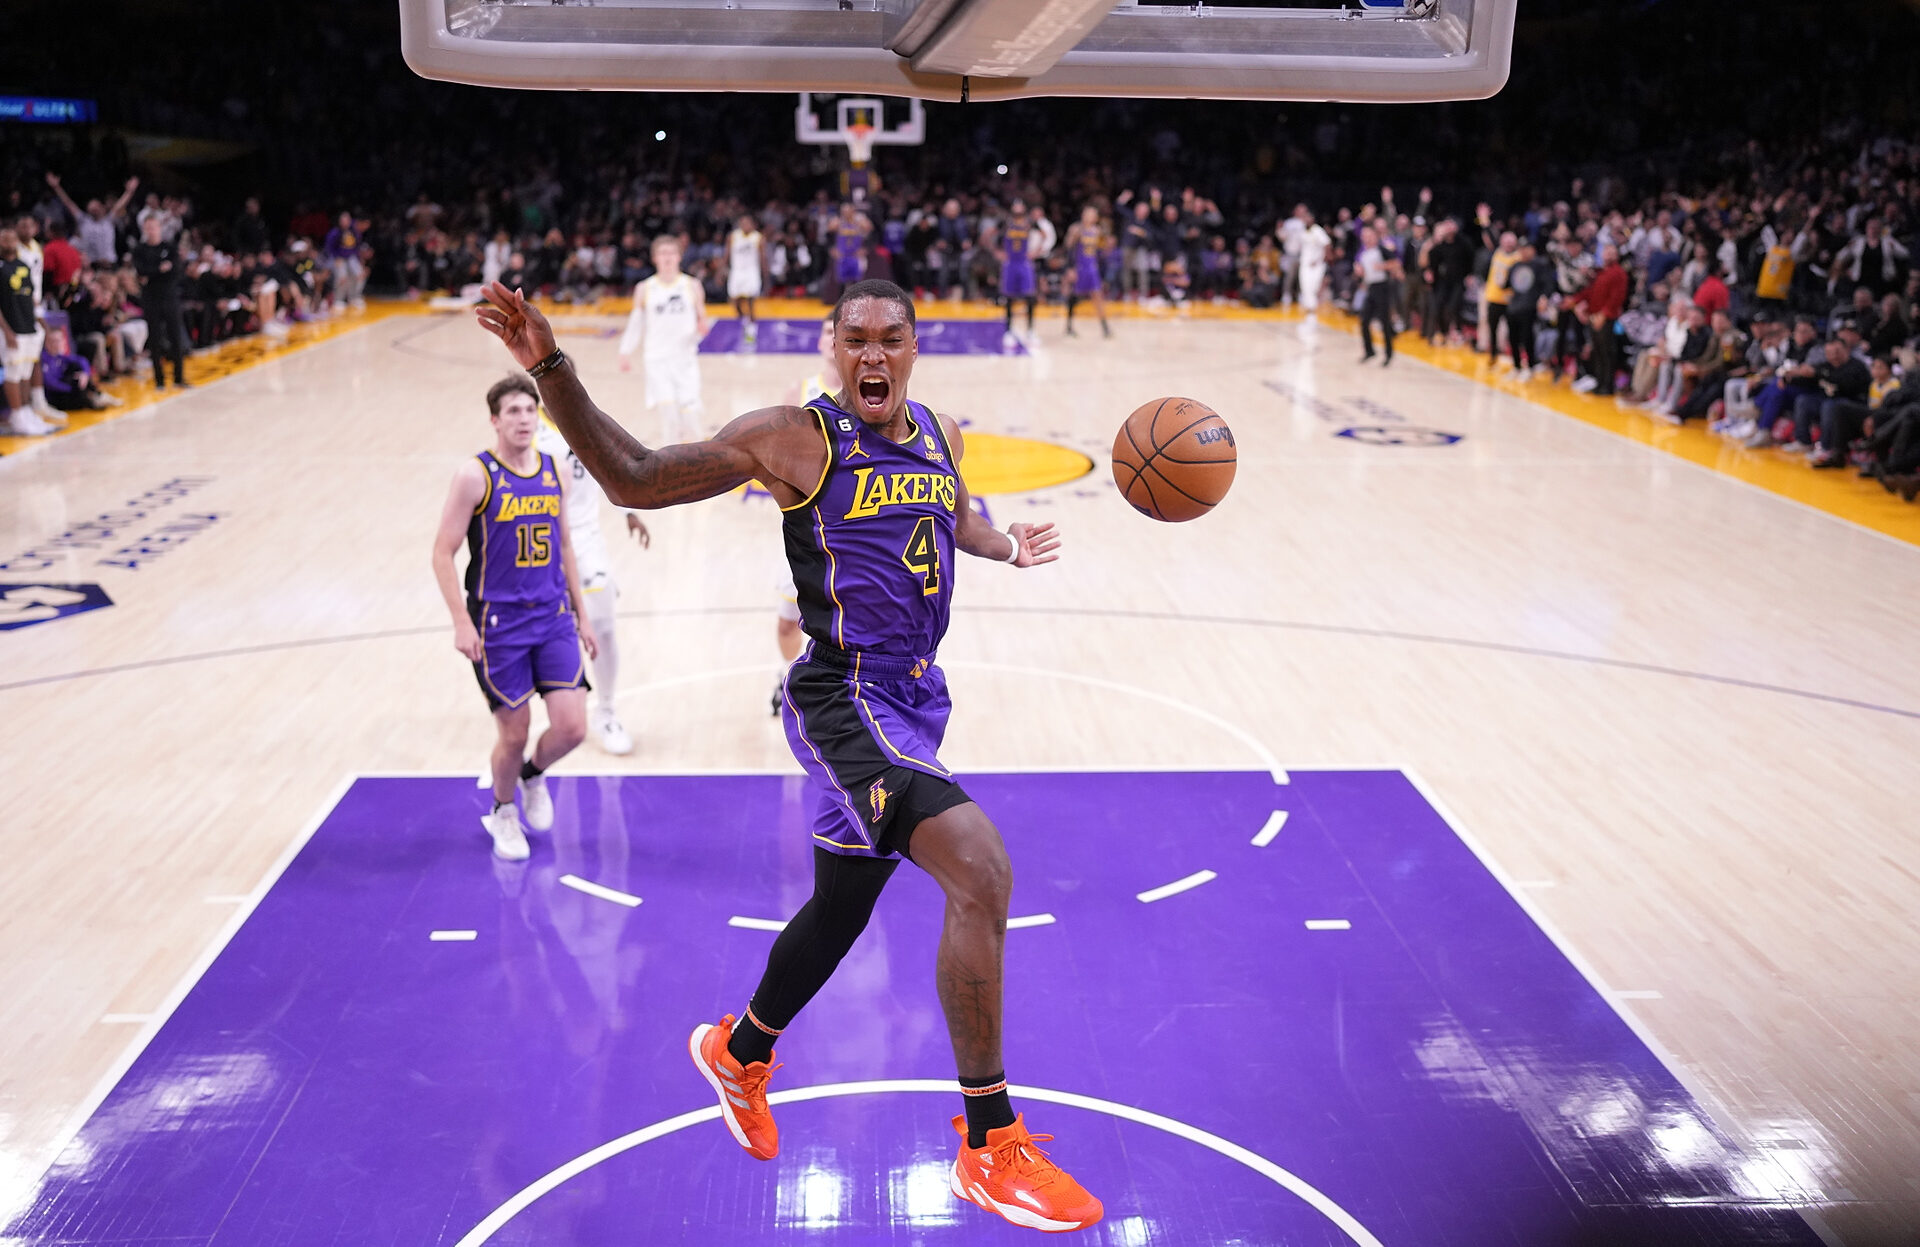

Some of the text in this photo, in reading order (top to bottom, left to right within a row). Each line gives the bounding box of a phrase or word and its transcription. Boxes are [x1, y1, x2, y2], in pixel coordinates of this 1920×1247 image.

[838, 418, 852, 432] 6
[494, 493, 561, 522] LAKERS
[843, 467, 956, 521] LAKERS
[515, 523, 552, 568] 15
[901, 516, 939, 597] 4
